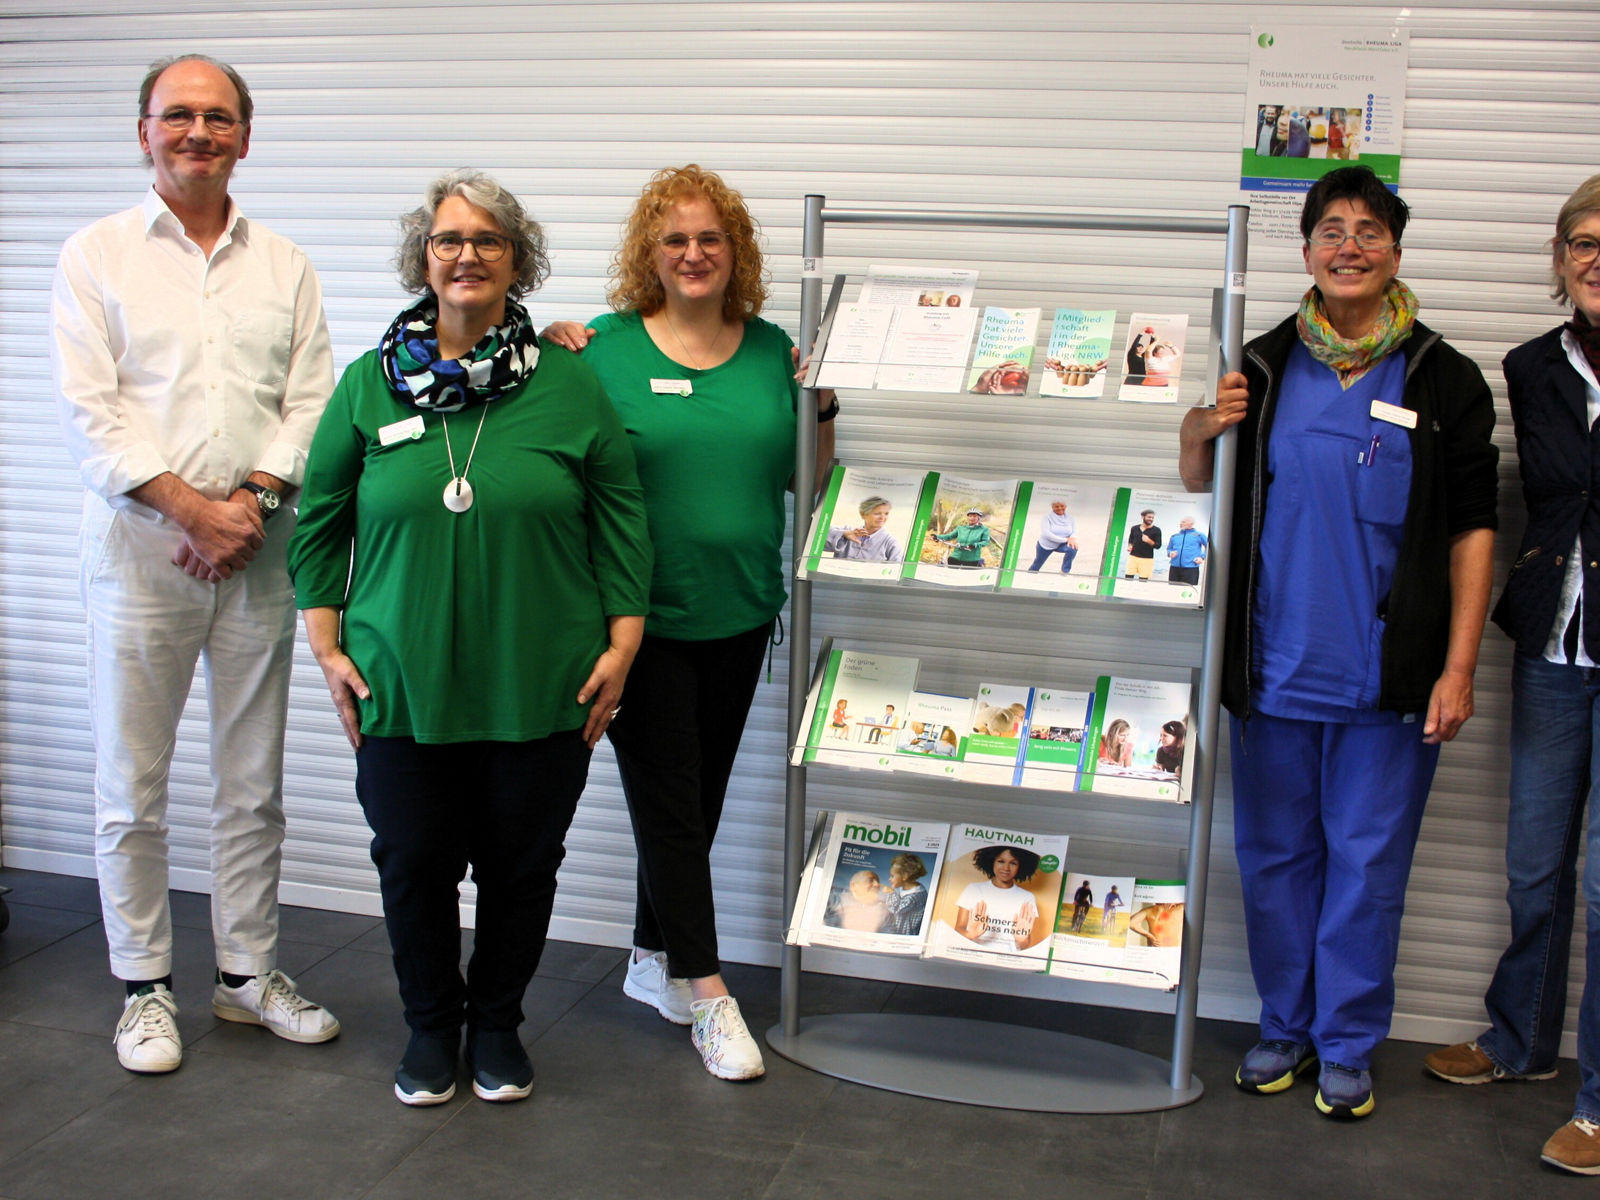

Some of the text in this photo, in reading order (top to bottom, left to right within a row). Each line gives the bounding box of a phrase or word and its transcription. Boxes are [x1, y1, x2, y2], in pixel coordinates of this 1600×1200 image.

[986, 316, 1025, 325] Rheuma
[984, 324, 1000, 332] hat
[1070, 333, 1087, 341] der
[980, 341, 1014, 350] Unsere
[978, 349, 1001, 358] Hilfe
[1077, 352, 1104, 360] NRW
[843, 824, 912, 847] mobil
[965, 827, 1035, 846] HAUTNAH
[974, 913, 1017, 927] Schmerz
[982, 922, 1031, 936] lass nach!
